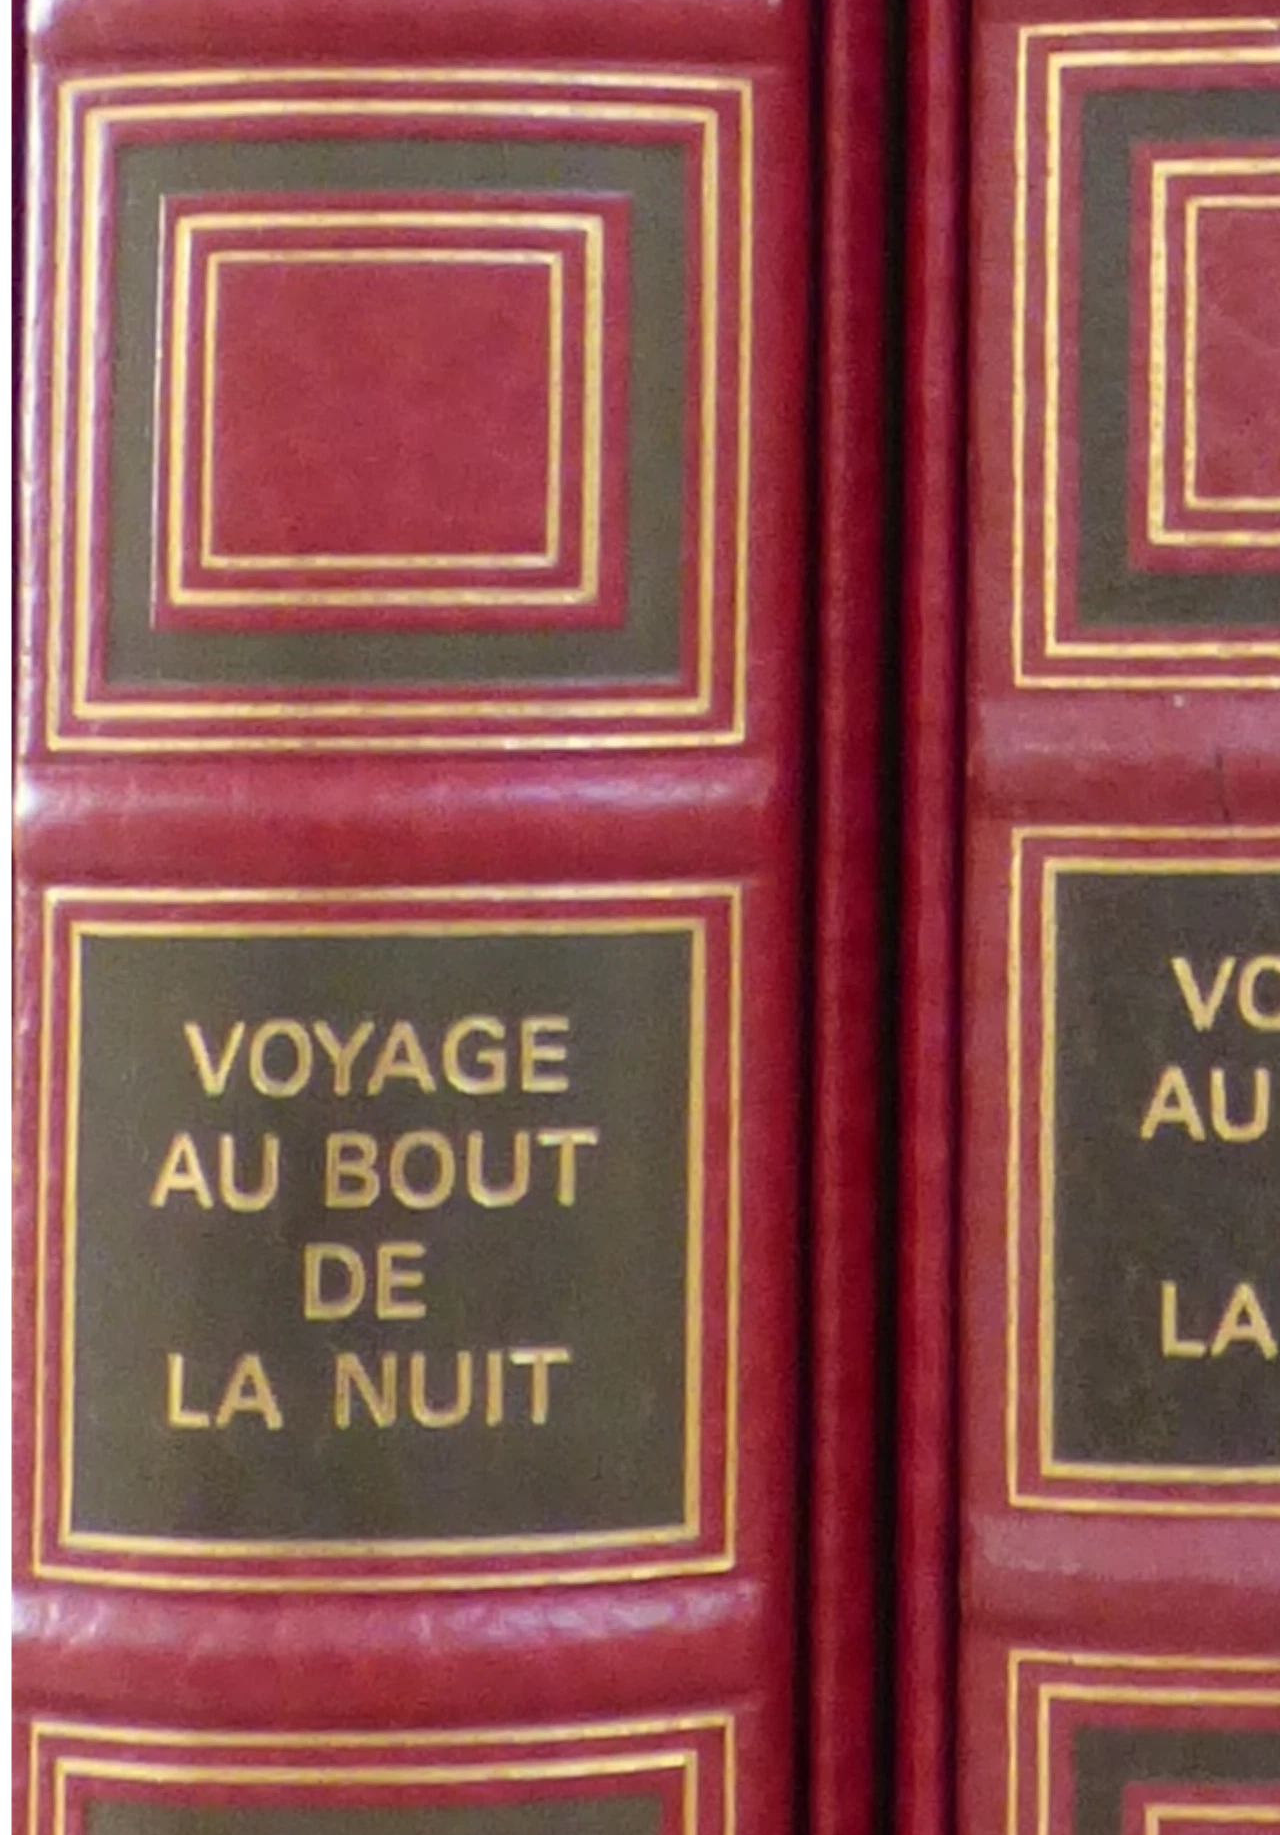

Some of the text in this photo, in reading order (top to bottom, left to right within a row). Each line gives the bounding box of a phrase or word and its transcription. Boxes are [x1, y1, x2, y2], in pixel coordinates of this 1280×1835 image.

[182, 1014, 571, 1098] VOYAGE
[1139, 1064, 1271, 1143] AU
[149, 1126, 600, 1212] AU BOUT
[303, 1240, 428, 1321] DE
[1160, 1279, 1279, 1361] LA
[166, 1346, 573, 1431] LA NUIT
